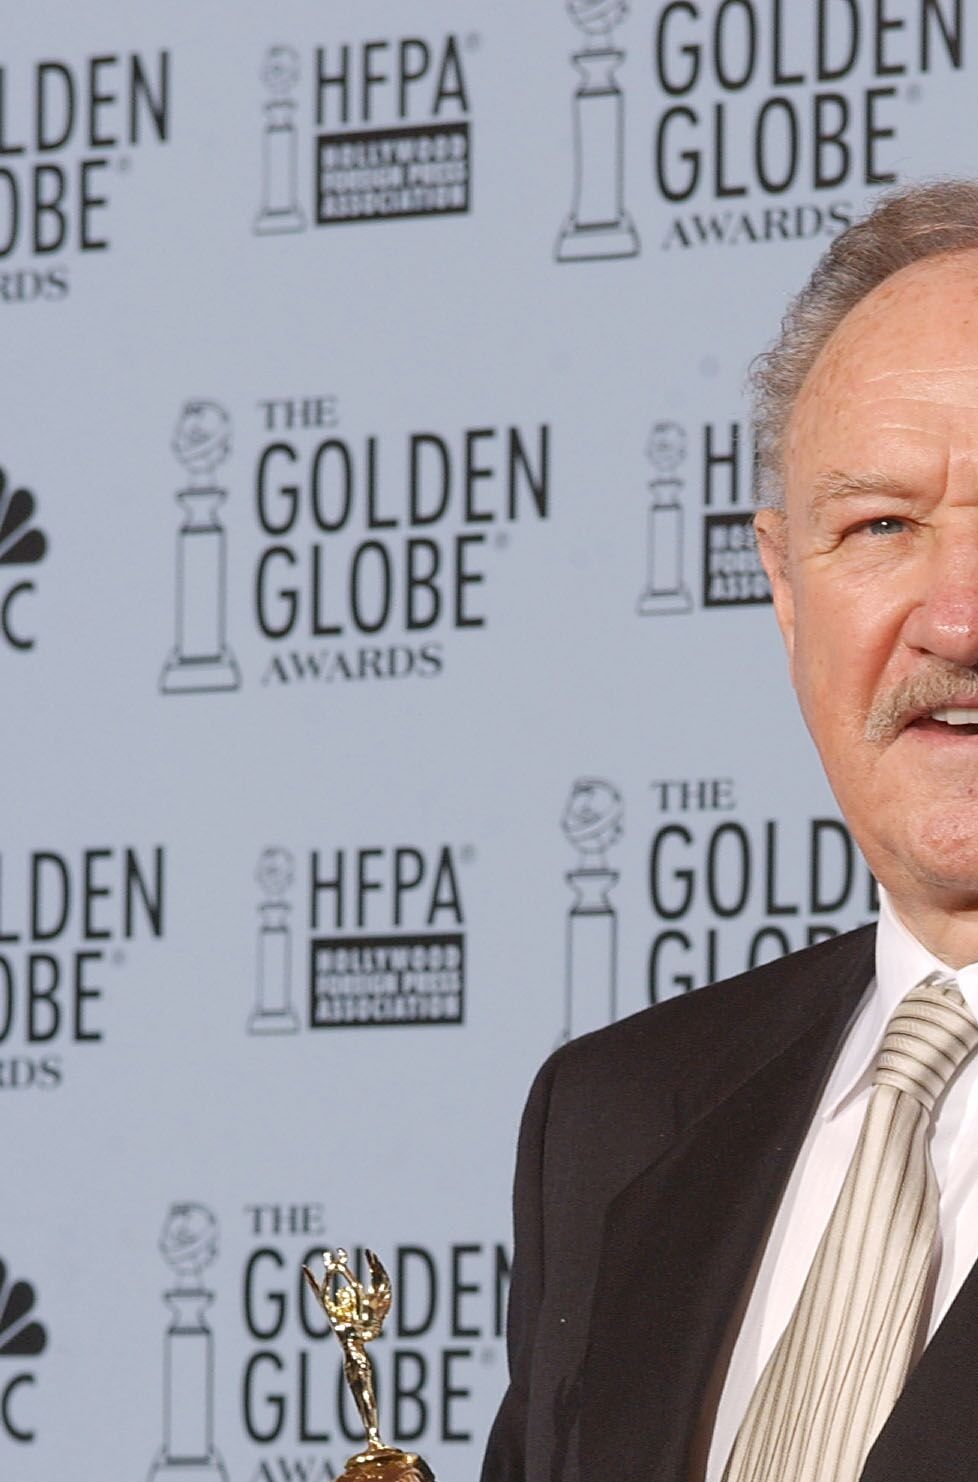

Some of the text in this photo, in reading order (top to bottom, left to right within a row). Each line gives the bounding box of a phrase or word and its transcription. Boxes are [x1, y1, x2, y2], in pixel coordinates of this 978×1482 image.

[315, 34, 470, 125] HFPA
[656, 0, 965, 96] GOLDEN
[655, 87, 897, 202] GLOBE
[662, 202, 851, 250] AWARDS
[259, 396, 338, 430] THE
[255, 423, 550, 537] GOLDEN
[255, 533, 486, 639] GLOBE
[261, 642, 443, 685] AWARDS
[651, 778, 736, 812] THE
[310, 845, 464, 929] HFPA
[648, 819, 879, 921] GOLD
[246, 1204, 325, 1236] THE
